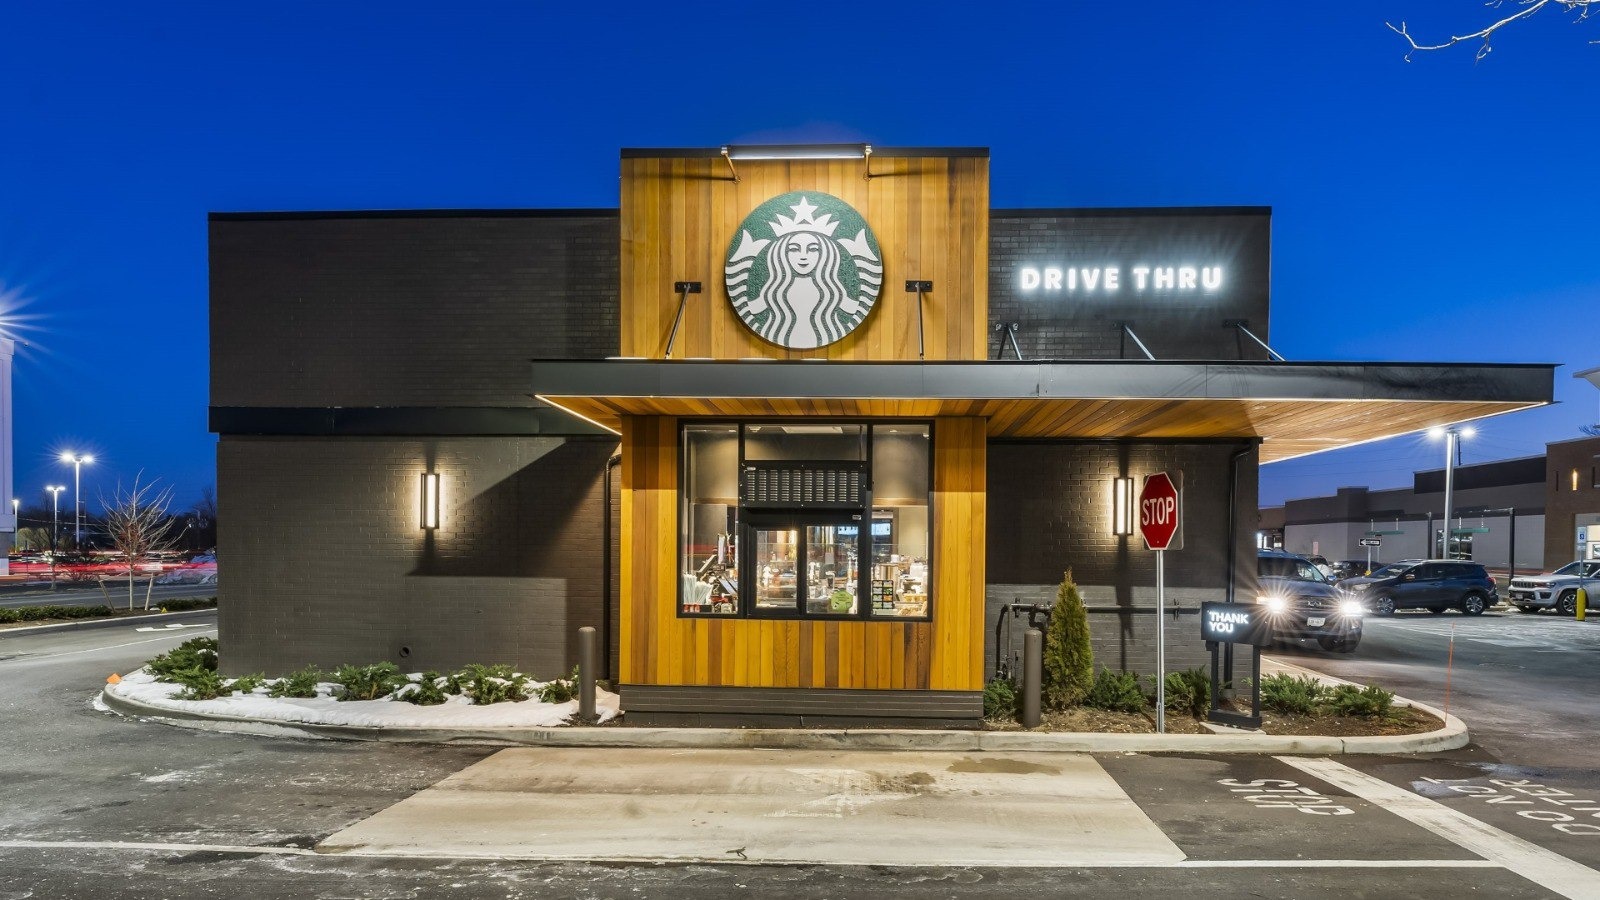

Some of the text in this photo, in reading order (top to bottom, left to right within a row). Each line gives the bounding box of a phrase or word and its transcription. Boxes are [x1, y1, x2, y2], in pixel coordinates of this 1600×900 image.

[1020, 267, 1222, 290] DRIVE THRU
[1141, 496, 1175, 526] STOP
[1208, 610, 1249, 624] THANK
[1209, 621, 1235, 633] YOU
[1216, 778, 1356, 816] STOP
